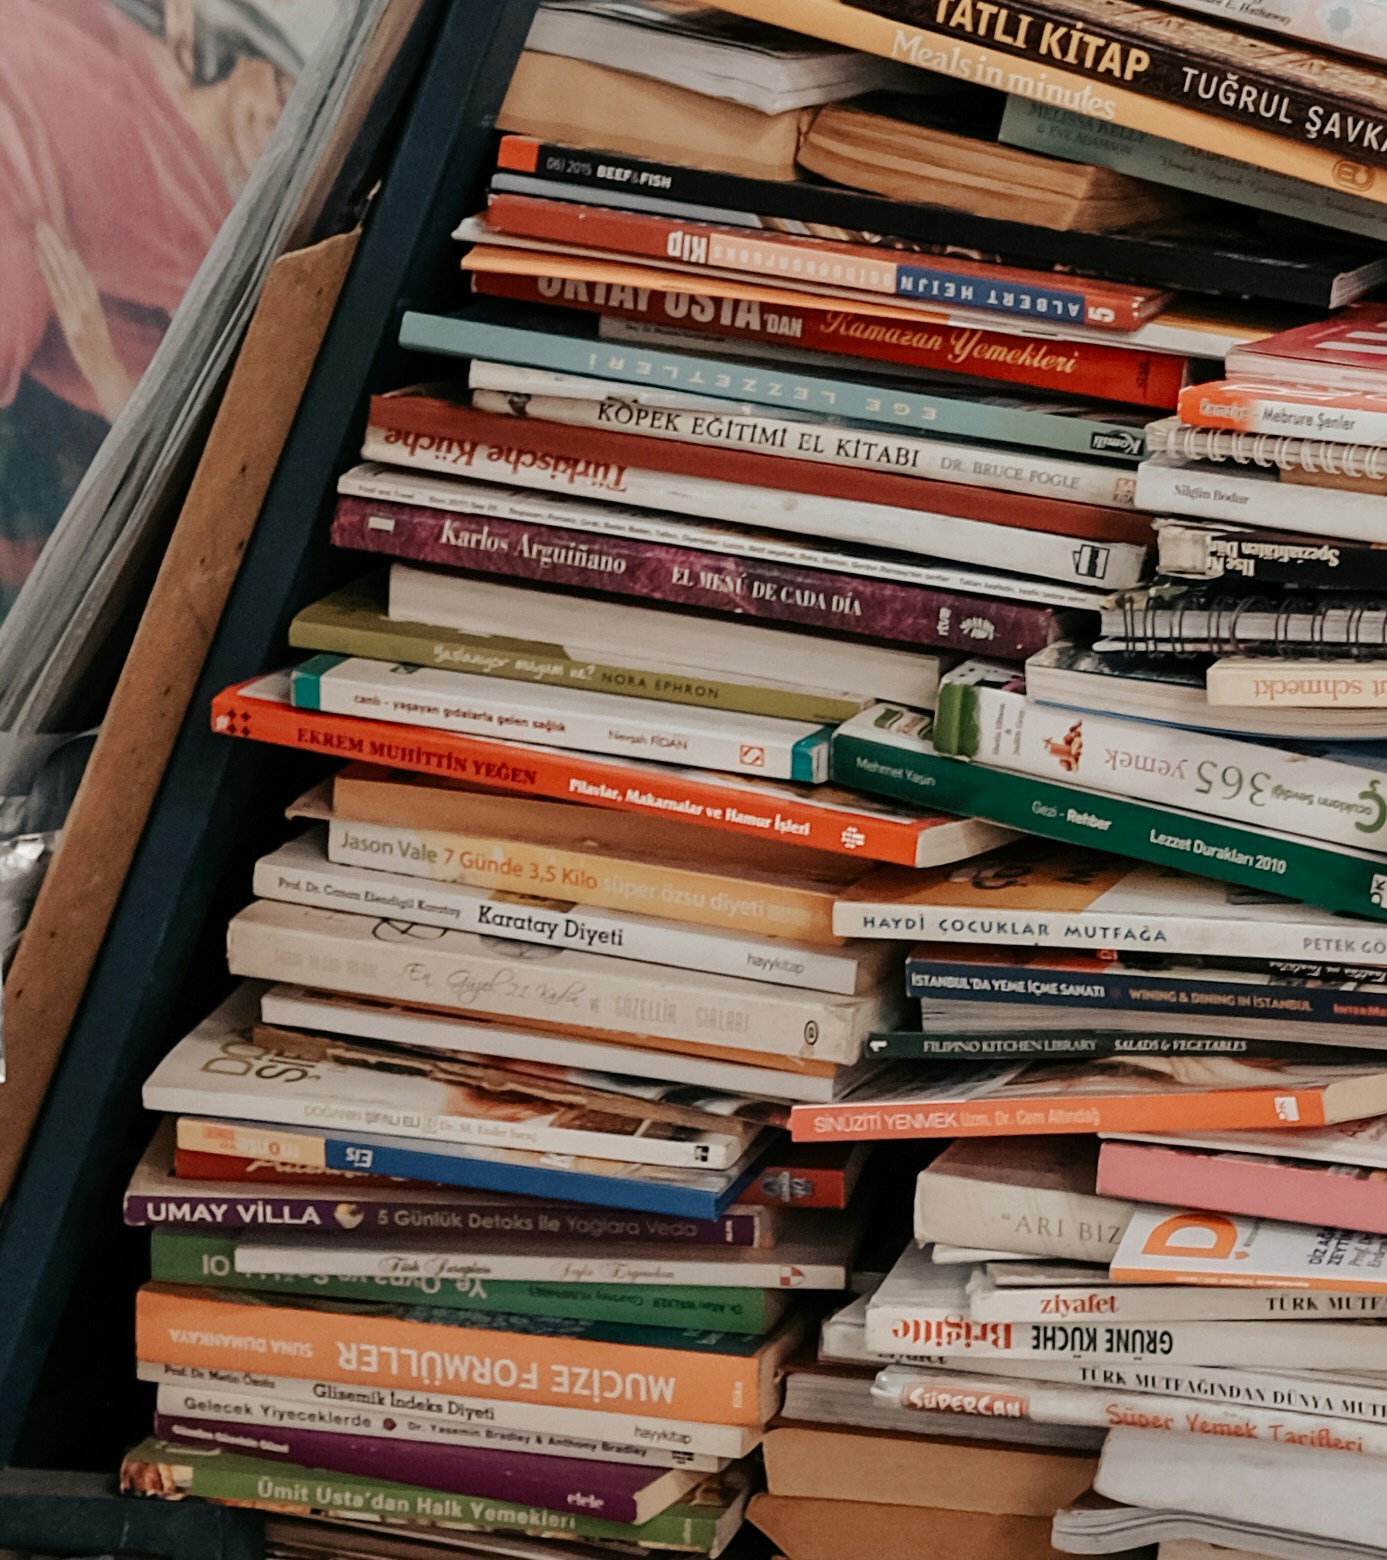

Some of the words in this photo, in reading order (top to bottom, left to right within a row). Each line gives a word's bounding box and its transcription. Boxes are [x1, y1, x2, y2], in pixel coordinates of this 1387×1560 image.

[1038, 20, 1152, 83] KİTAP
[891, 29, 972, 78] Meals
[978, 51, 1003, 84] in
[1008, 61, 1116, 121] minutes
[1182, 65, 1293, 127] TUĞRUL
[899, 276, 975, 301] HEIJN
[986, 289, 1081, 319] ALBERT
[439, 520, 511, 555] Karlos
[516, 533, 628, 576] Arguiñano
[601, 672, 647, 689] NORA
[654, 678, 720, 699] EPHRON
[1251, 677, 1364, 704] schmeckt
[296, 727, 364, 756] EKREM
[368, 736, 469, 774] MUHİTTİN
[472, 754, 537, 786] YEĞEN
[1149, 827, 1191, 853] Lezzet
[1193, 833, 1254, 868] Durakları
[1255, 852, 1287, 876] 2010
[477, 904, 559, 938] Karatay
[562, 918, 625, 947] Diyeti
[862, 911, 926, 932] HAYDİ
[938, 917, 1050, 938] ÇOCUKLAR
[1064, 923, 1167, 944] MUTFAĞA
[1302, 935, 1357, 953] PETEK
[923, 1040, 979, 1053] FILIPINO
[981, 1039, 1042, 1052] KITCHEN
[1044, 1039, 1097, 1053] LIBRARY
[1114, 1038, 1159, 1052] SALADS
[1173, 1039, 1247, 1052] VEGETABLES
[1039, 1292, 1119, 1318] ziyafet
[1265, 1294, 1319, 1313] TÜRK
[1031, 1324, 1097, 1359] KÜCHE
[1104, 1326, 1174, 1361] GRÜNE
[336, 1340, 539, 1397] FORMÜLLER
[551, 1362, 676, 1408] MUCİZE
[1079, 1365, 1129, 1388] TÜRK
[1135, 1370, 1267, 1406] MUTFAĞINDAN
[1272, 1387, 1336, 1414] DÜNYA
[1105, 1402, 1178, 1434] Süper
[1184, 1412, 1259, 1441] Yemek
[1267, 1421, 1364, 1455] Tarifleri
[257, 1478, 309, 1505] Ümit
[315, 1486, 410, 1514] Usta'dan
[416, 1496, 464, 1520] Halk
[469, 1502, 576, 1530] Yemekleri
